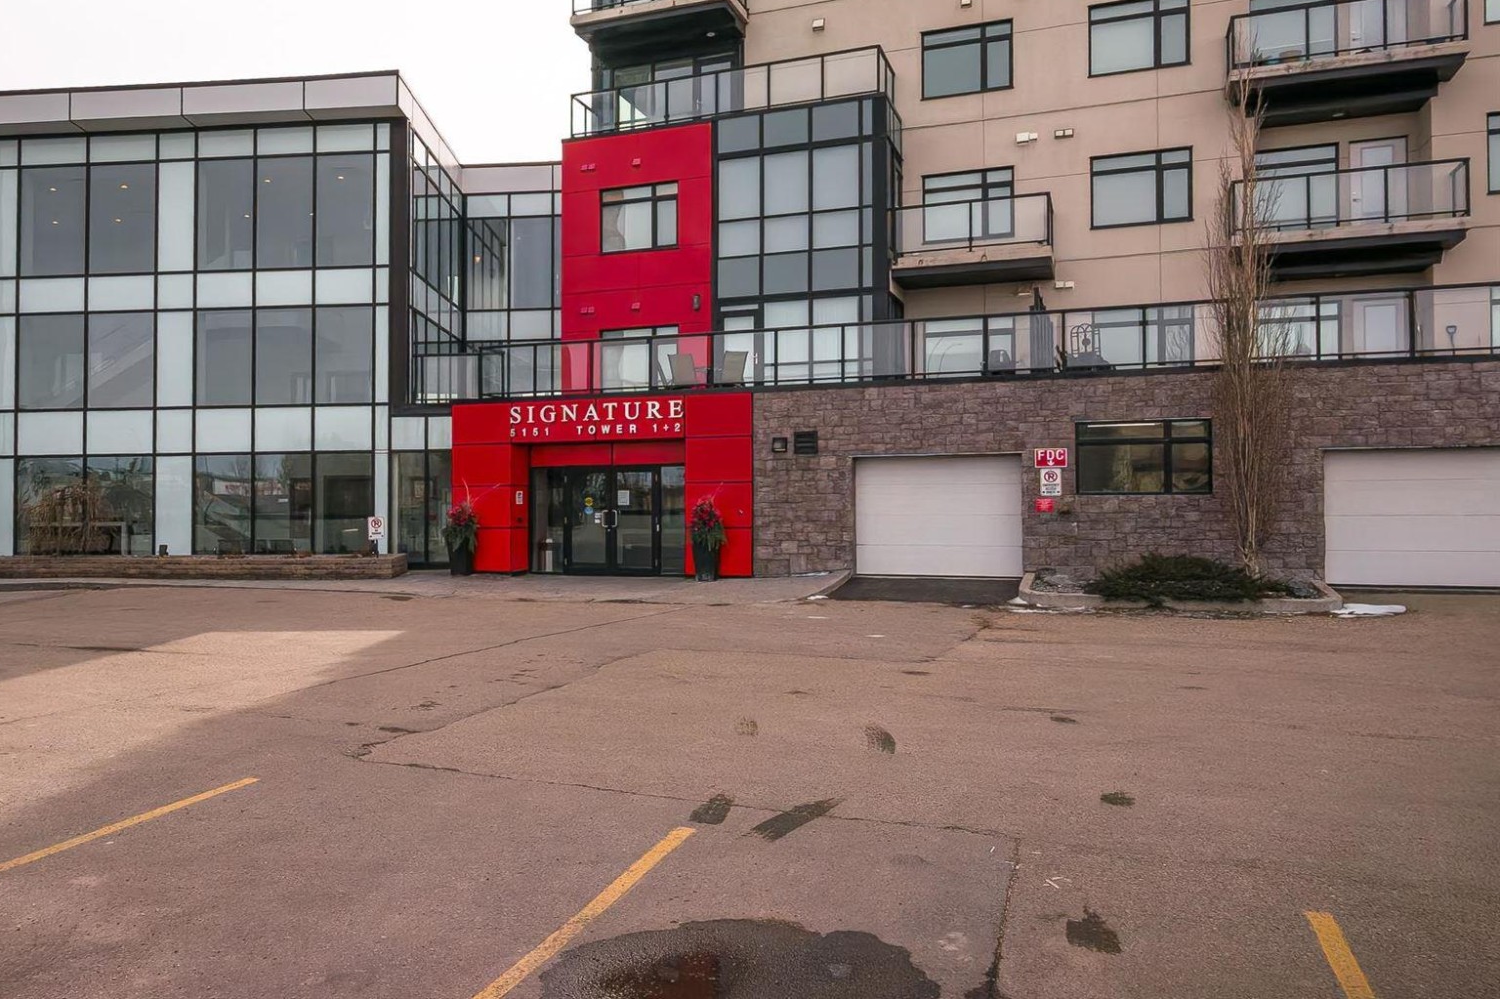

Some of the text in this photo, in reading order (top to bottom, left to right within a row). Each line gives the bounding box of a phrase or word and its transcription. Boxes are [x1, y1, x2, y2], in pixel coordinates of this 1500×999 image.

[510, 400, 684, 424] SIGNATURE
[510, 427, 549, 437] 5151
[576, 424, 637, 435] TOWER
[1037, 449, 1065, 461] FDC
